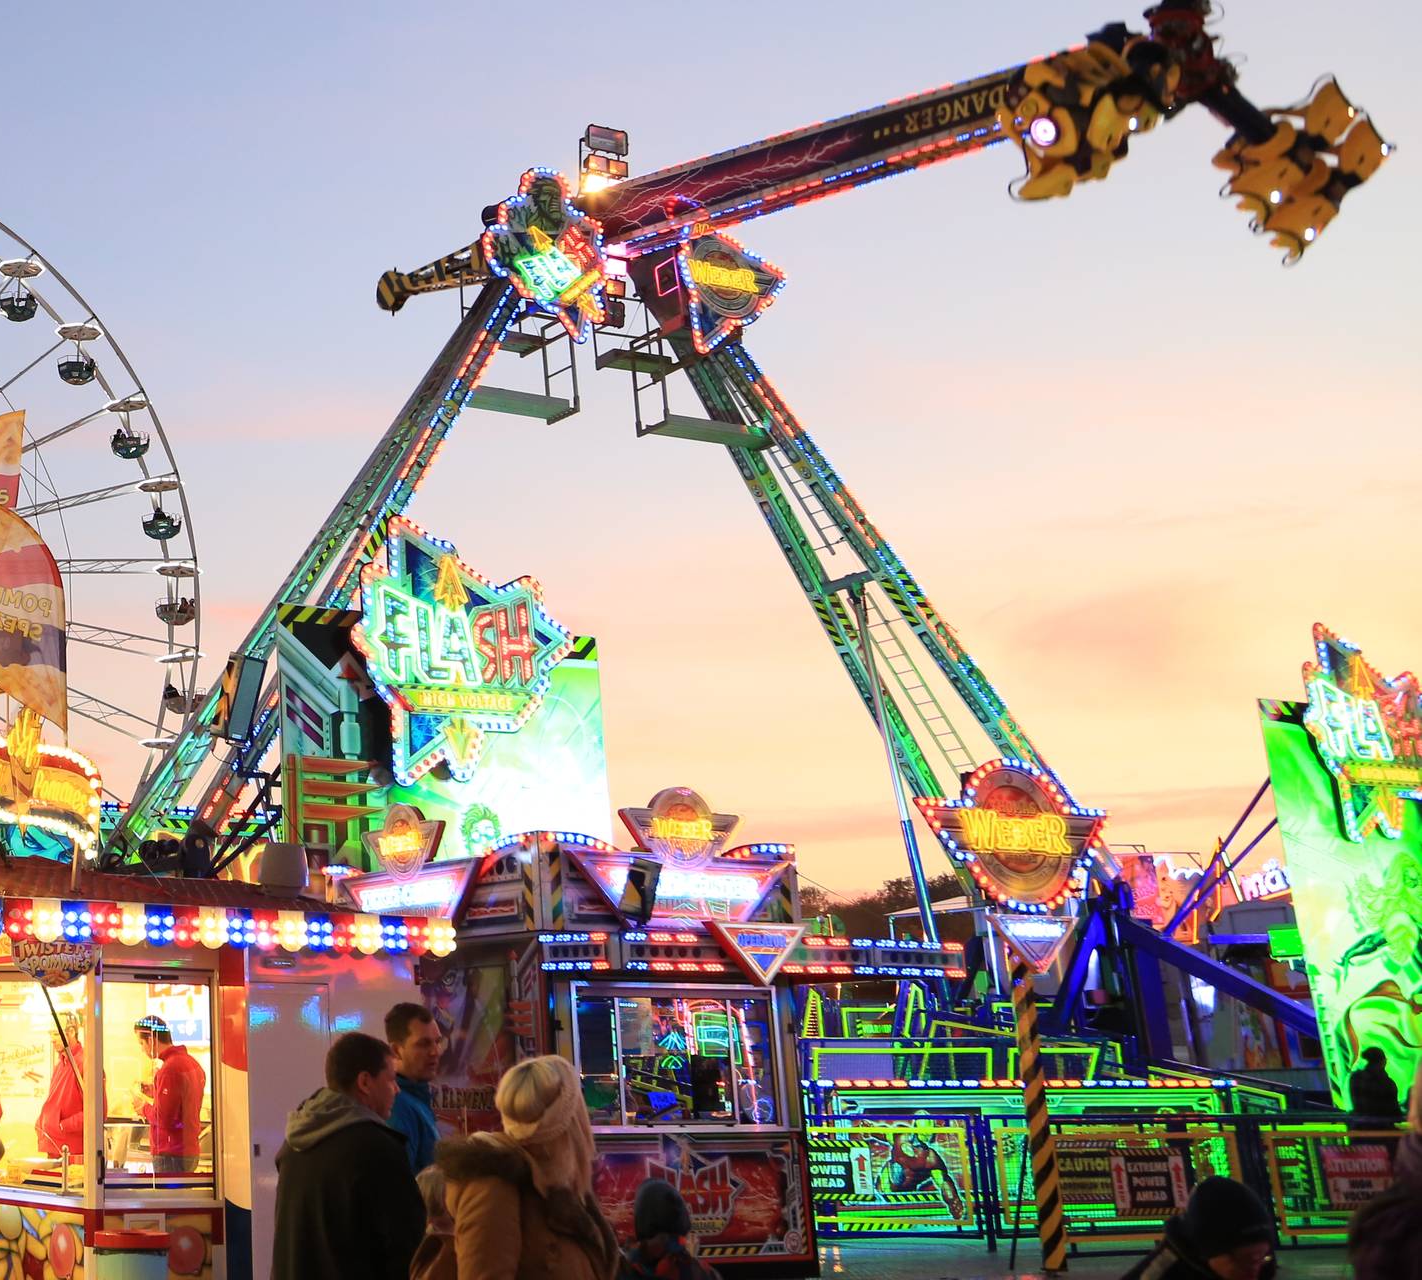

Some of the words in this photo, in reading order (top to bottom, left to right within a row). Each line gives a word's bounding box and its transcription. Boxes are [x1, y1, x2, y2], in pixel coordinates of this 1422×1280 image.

[687, 259, 759, 293] WEBER
[372, 585, 540, 689] FLASH
[651, 816, 715, 841] WEBER
[959, 808, 1072, 855] WEBER
[808, 1151, 850, 1162] TREME
[809, 1164, 846, 1175] OWER
[1128, 1161, 1168, 1173] EXTREME
[1132, 1175, 1166, 1188] POWER
[1136, 1190, 1167, 1201] AHEAD
